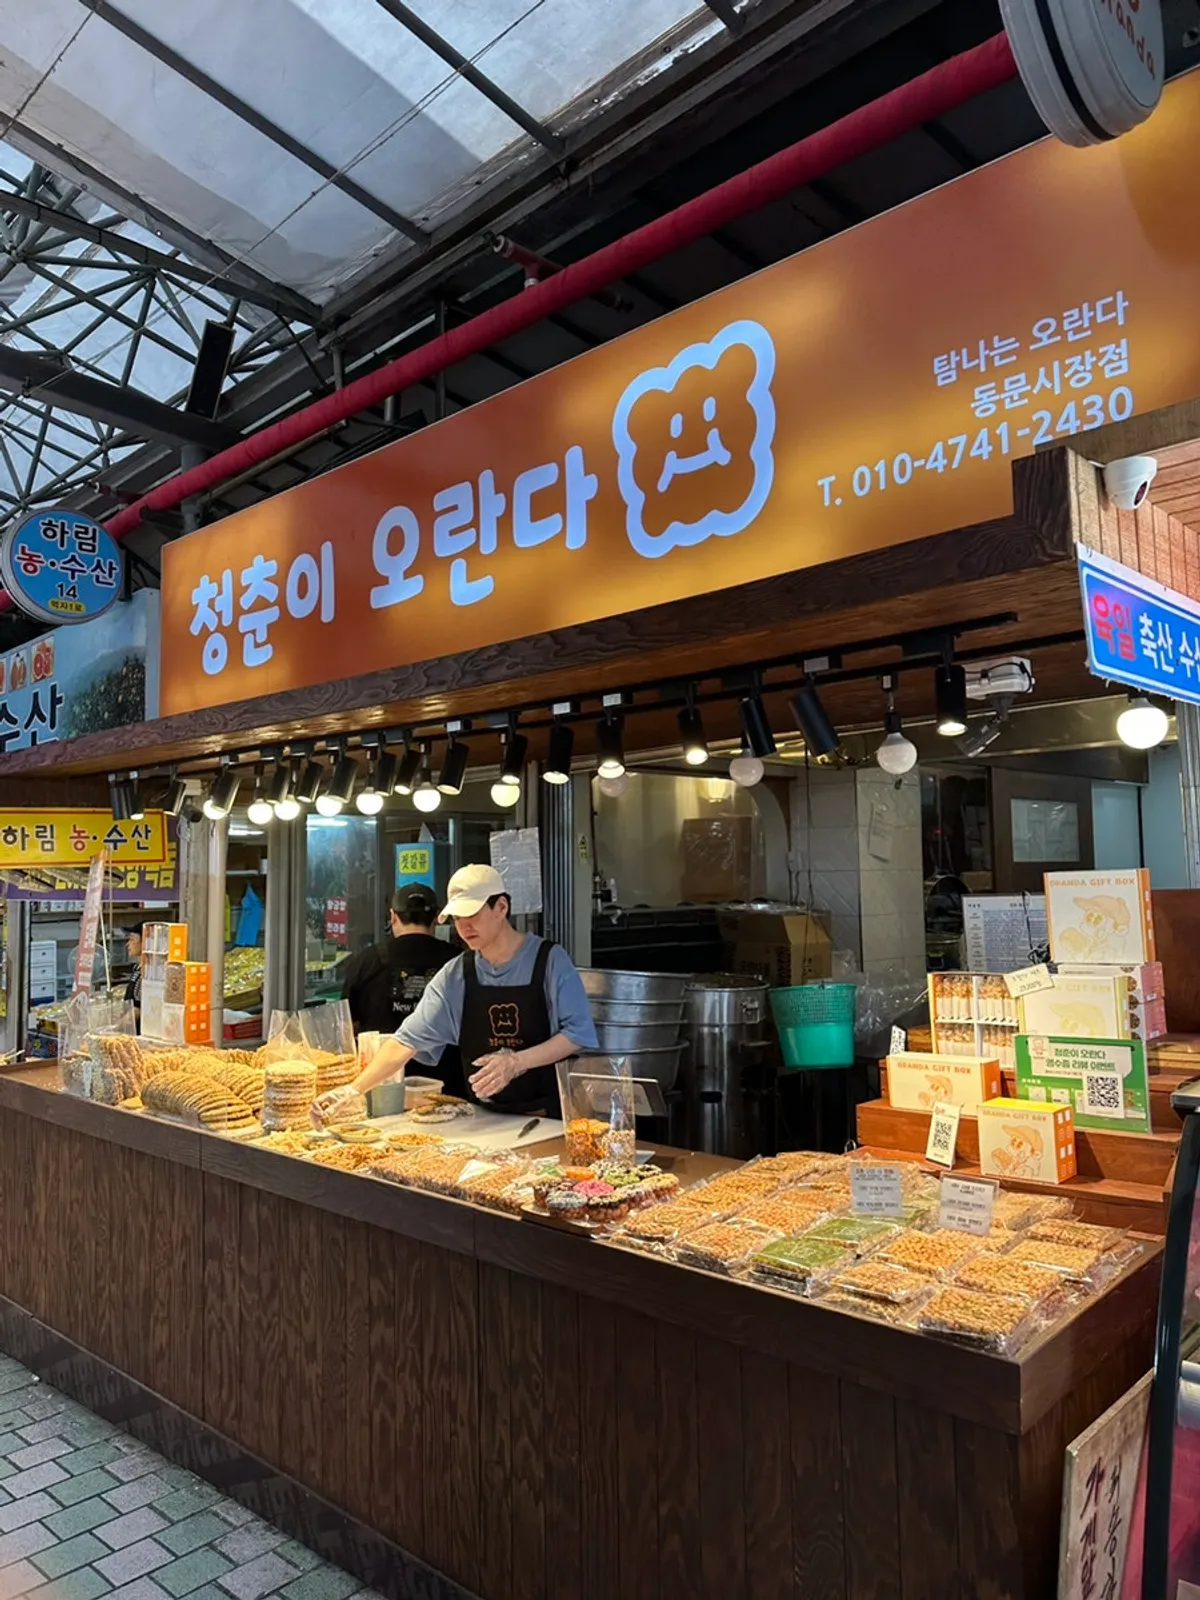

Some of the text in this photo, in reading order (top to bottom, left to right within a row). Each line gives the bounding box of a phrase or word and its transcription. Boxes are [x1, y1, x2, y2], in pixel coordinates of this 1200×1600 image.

[932, 290, 1130, 386] 탐나는 오란다
[970, 338, 1130, 418] 동문시장점
[817, 386, 1135, 507] T. 010-4741-2430
[39, 518, 98, 555] 하림
[189, 444, 599, 675] 청춘이 오란다
[56, 582, 78, 599] 14
[1091, 594, 1137, 662] 육일
[1138, 611, 1175, 674] 축산
[2, 823, 56, 852] 하림
[1089, 878, 1112, 887] GIFT
[1114, 877, 1136, 886] BOX
[392, 1002, 412, 1012] New
[932, 1065, 953, 1073] GIFT
